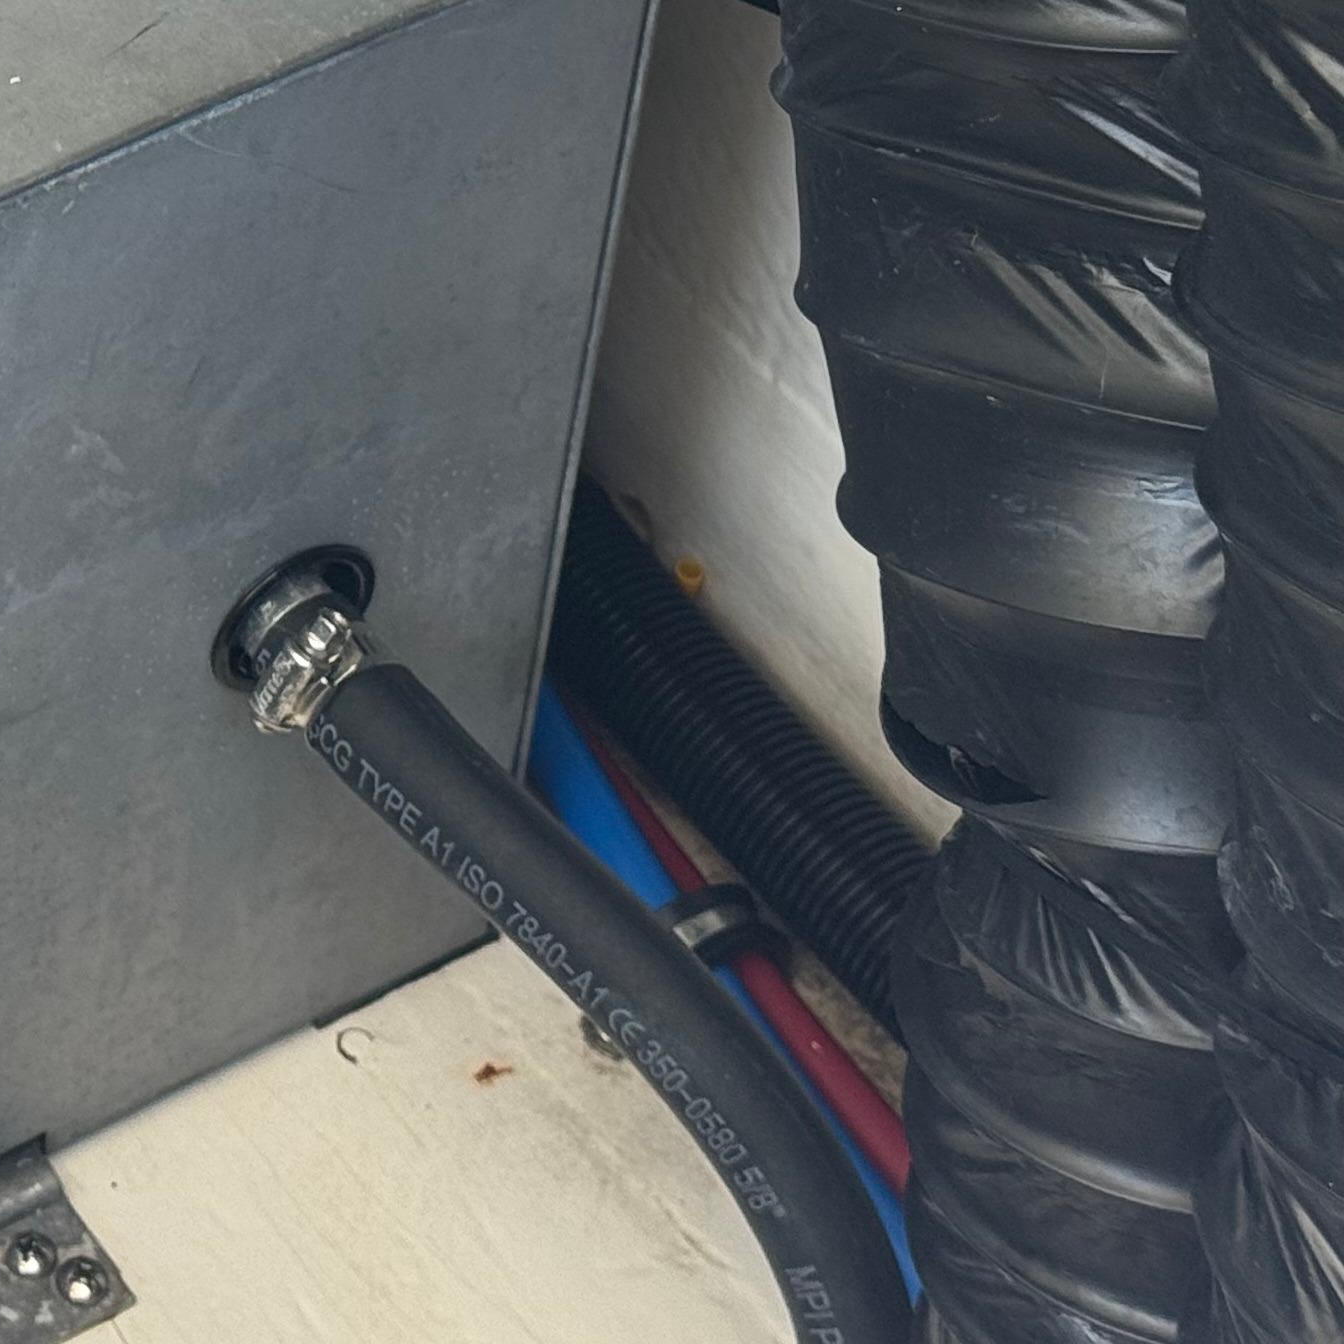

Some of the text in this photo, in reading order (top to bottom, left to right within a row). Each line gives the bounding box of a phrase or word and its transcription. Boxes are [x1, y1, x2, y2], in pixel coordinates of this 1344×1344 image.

[357, 759, 424, 835] TYPE
[420, 826, 455, 868] A1
[456, 857, 505, 912] ISO
[505, 900, 610, 1009] 7840-A1
[636, 1039, 748, 1166] 350-0580
[784, 1263, 835, 1320] MPI
